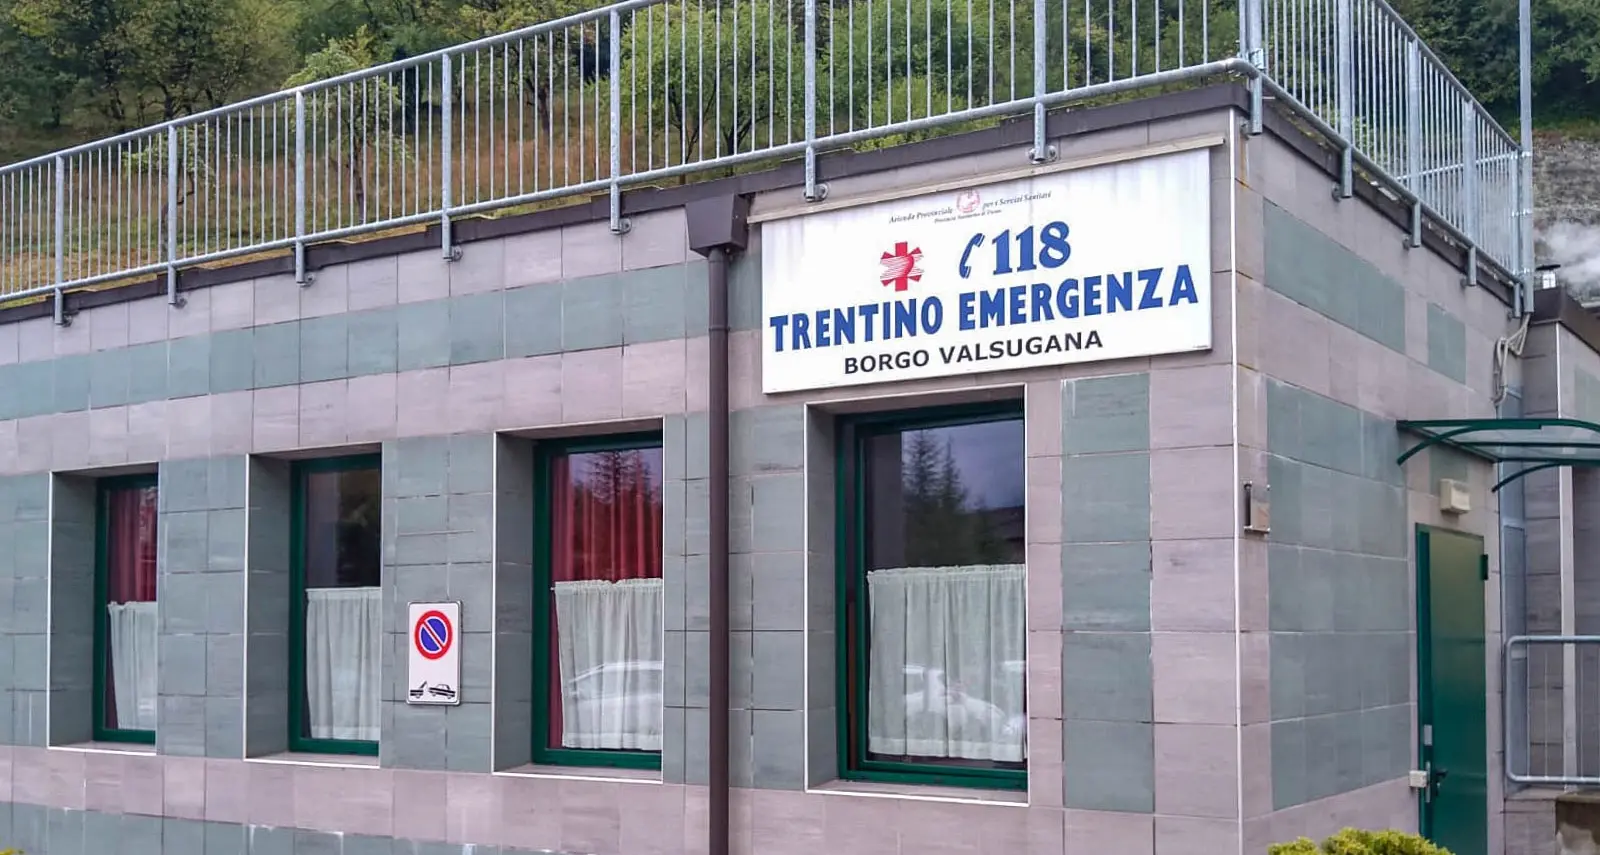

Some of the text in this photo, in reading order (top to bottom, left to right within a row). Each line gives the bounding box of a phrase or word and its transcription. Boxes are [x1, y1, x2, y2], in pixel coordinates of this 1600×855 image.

[889, 214, 915, 224] Azienda
[917, 207, 953, 219] Provinciale
[999, 196, 1023, 206] Servizi
[1024, 190, 1052, 201] Sanitari
[992, 221, 1072, 275] 118
[769, 264, 1199, 353] TRENTINO EMERGENZA
[843, 329, 1104, 375] BORGO VALSUGANA
